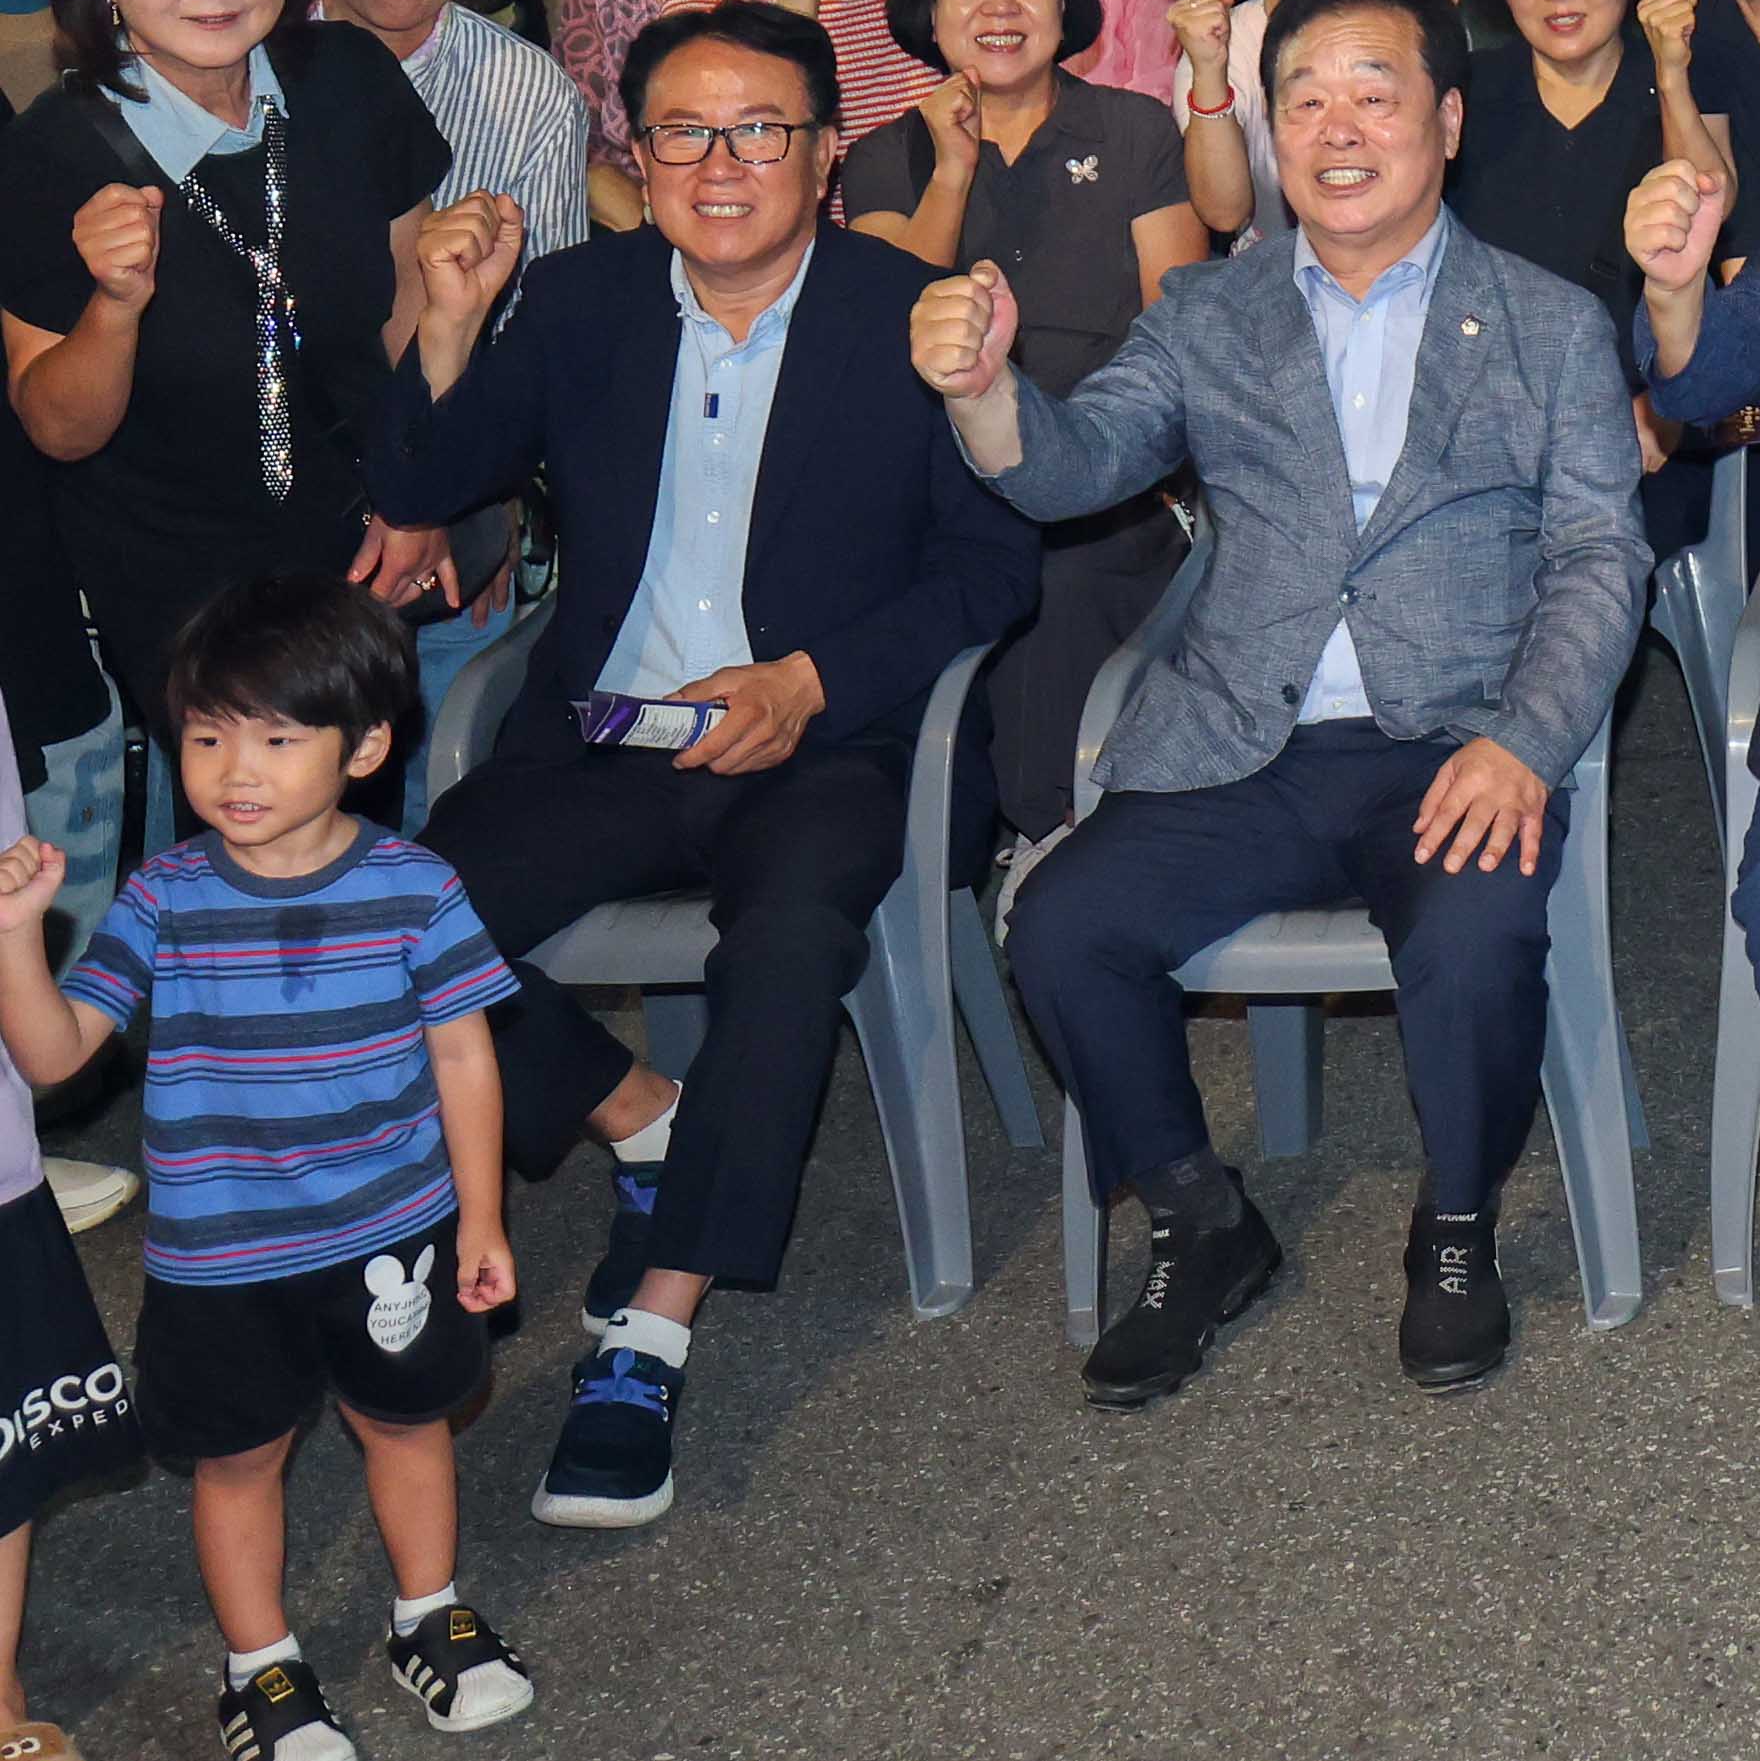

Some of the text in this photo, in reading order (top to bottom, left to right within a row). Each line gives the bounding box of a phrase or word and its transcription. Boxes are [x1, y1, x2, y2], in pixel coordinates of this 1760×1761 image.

[1139, 1260, 1176, 1309] MAX
[1439, 1246, 1468, 1295] AIR
[29, 1398, 129, 1451] EXPED
